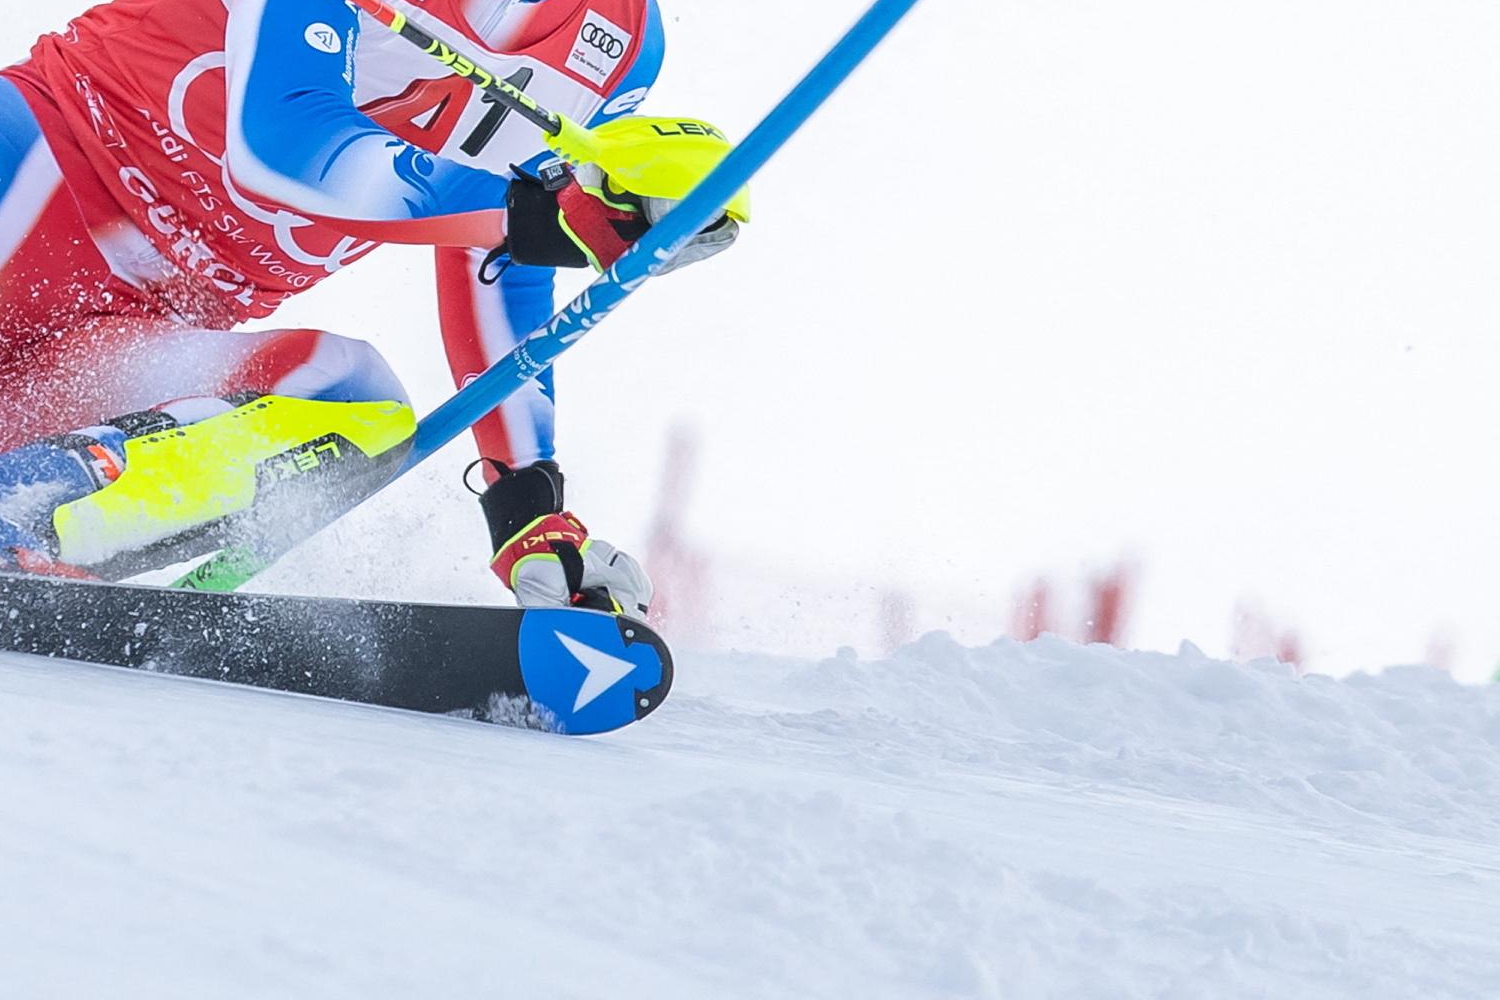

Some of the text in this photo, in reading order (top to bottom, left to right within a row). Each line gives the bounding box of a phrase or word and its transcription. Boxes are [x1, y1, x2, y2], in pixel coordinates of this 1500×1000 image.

[423, 39, 493, 89] LEKI
[135, 107, 310, 288] udi FIS Ski World
[522, 531, 580, 550] LEKI
